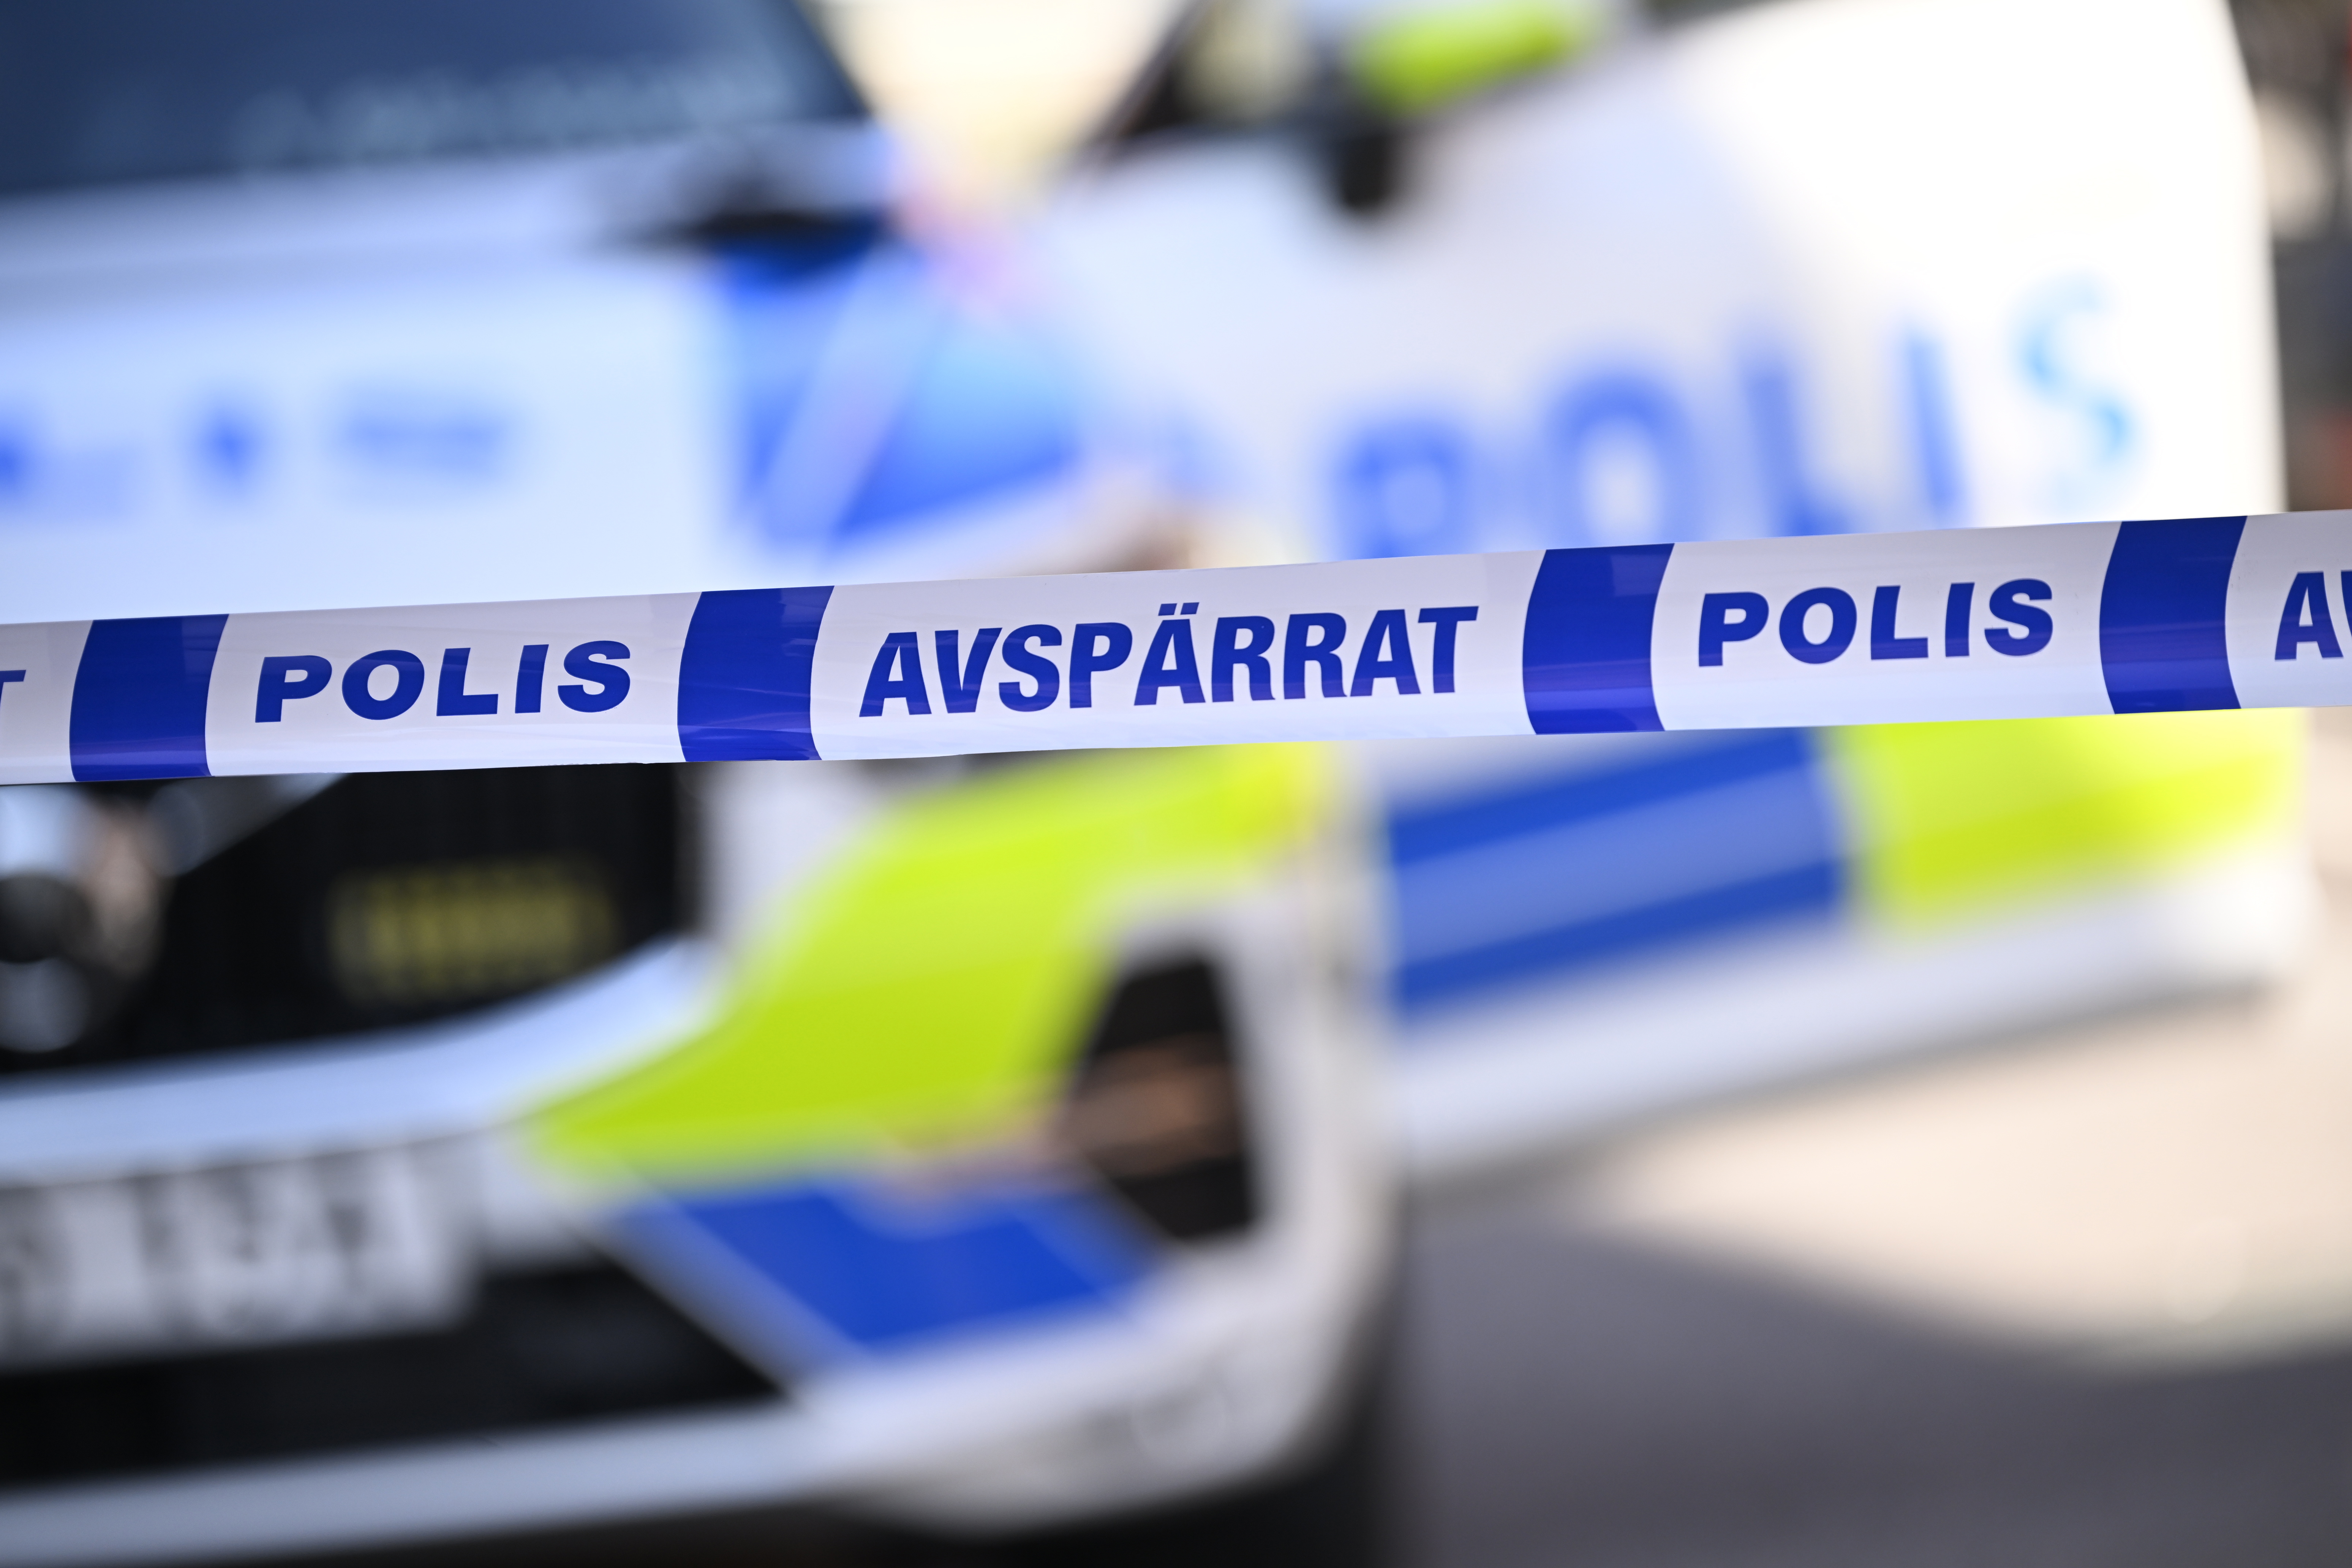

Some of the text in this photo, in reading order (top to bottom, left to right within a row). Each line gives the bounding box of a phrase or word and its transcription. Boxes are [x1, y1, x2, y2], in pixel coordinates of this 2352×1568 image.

[254, 569, 2352, 723] POLIS AVSPÄRRAT POLIS A
